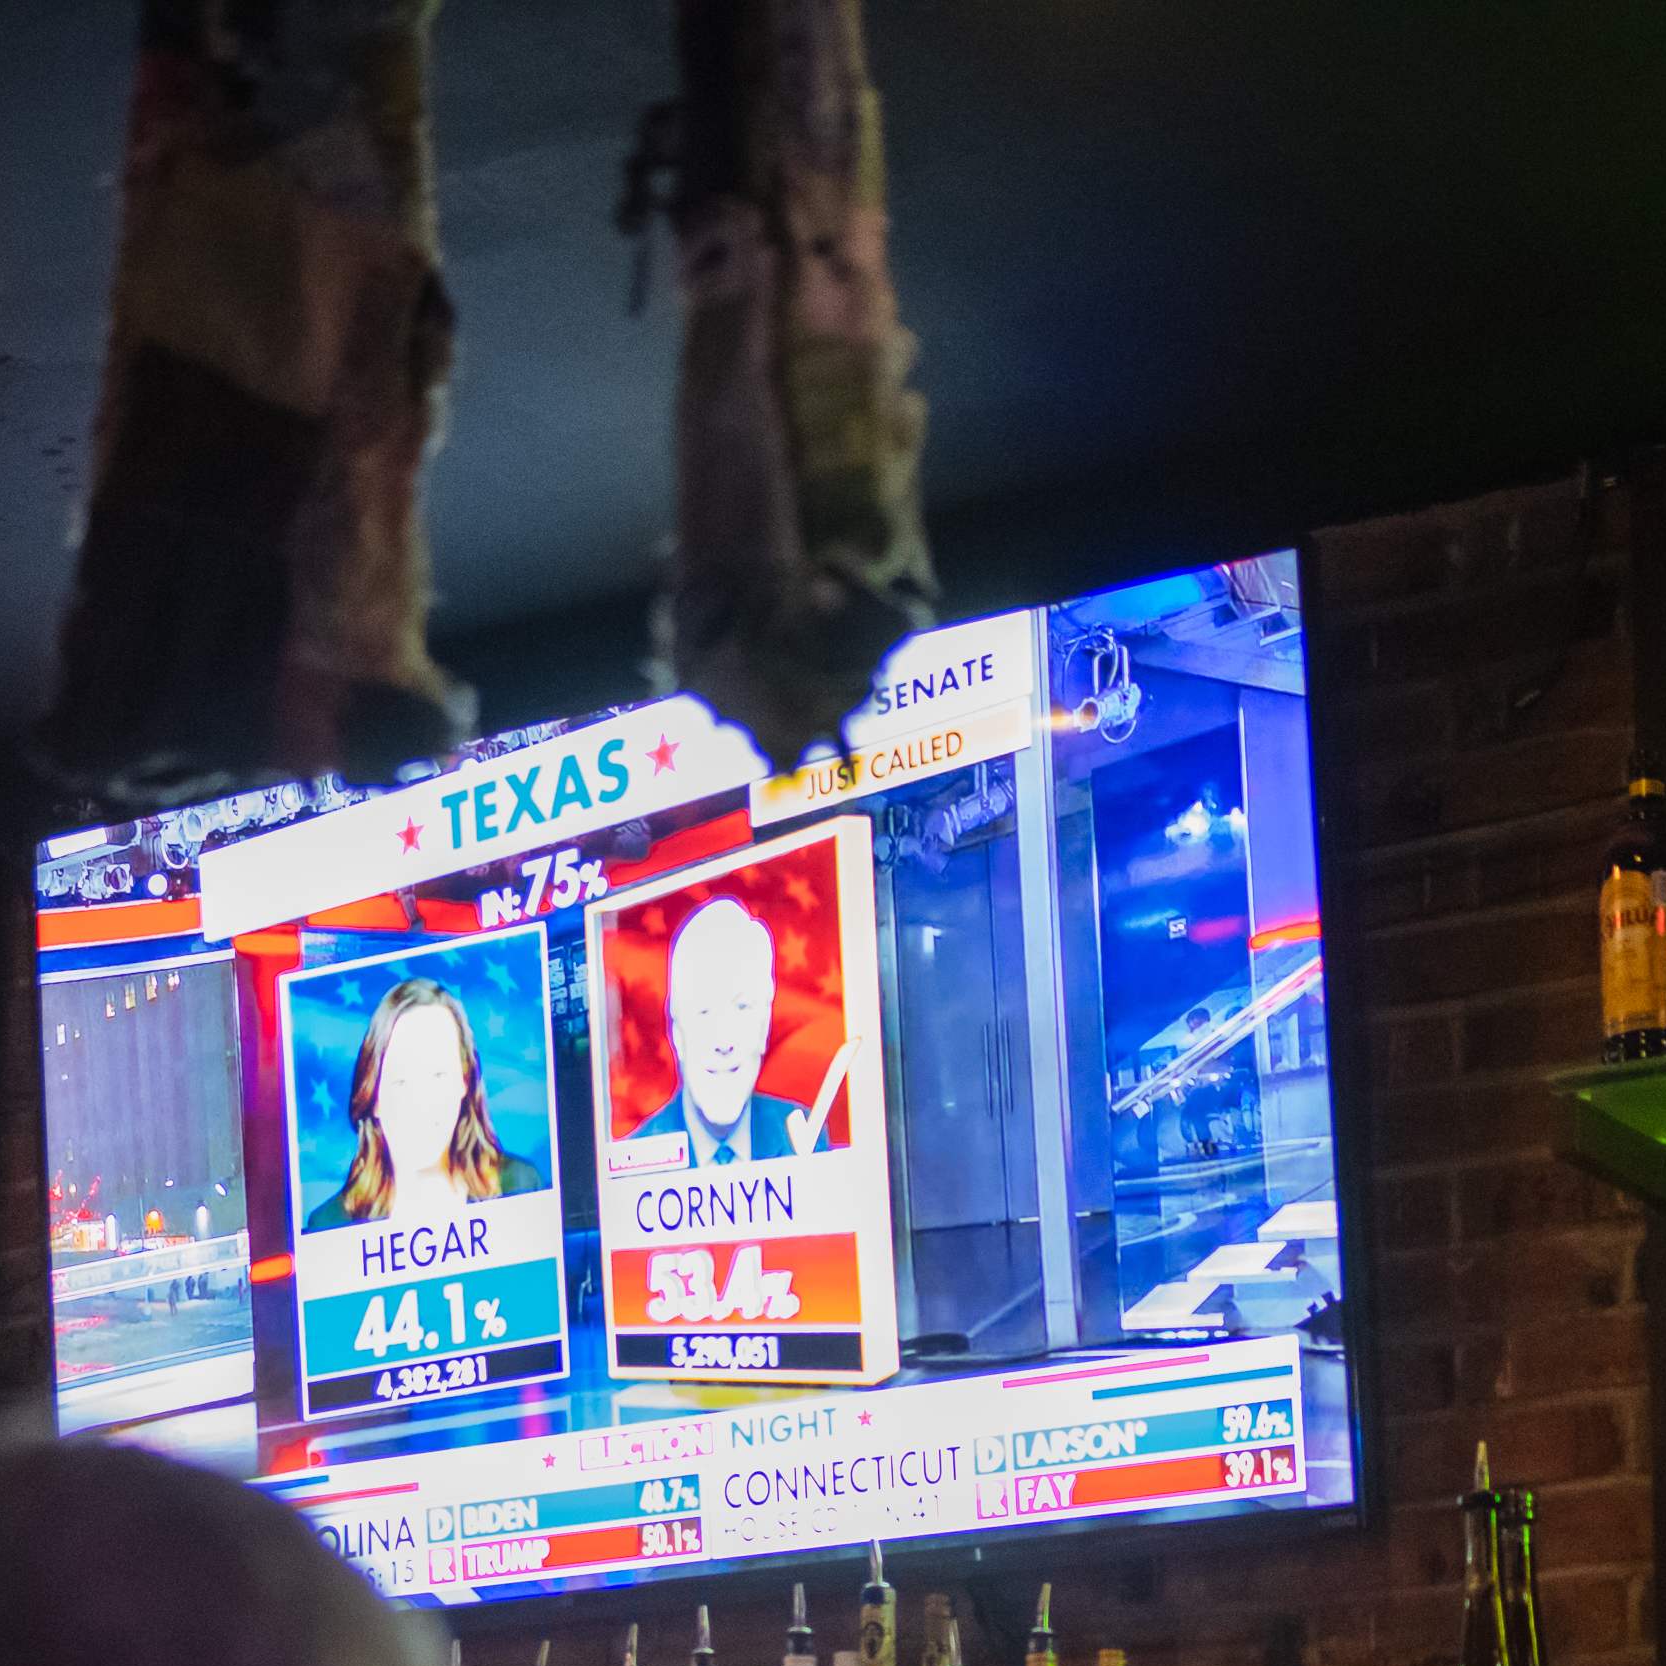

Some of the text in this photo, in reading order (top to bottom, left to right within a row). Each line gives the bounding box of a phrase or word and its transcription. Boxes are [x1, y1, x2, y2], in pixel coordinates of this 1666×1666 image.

[876, 652, 995, 716] SENATE
[441, 738, 631, 850] TEXAS
[808, 730, 964, 800] JUST CALLED
[521, 847, 610, 914] 75%
[636, 1175, 795, 1233] CORNYN
[361, 1217, 490, 1277] HEGAR
[353, 1281, 508, 1358] 44.1%
[731, 1407, 837, 1450] NIGHT
[976, 1435, 1005, 1472] D
[724, 1445, 963, 1510] CONNECTICUT
[978, 1483, 1007, 1520] R
[1017, 1471, 1077, 1514] FAY
[319, 1515, 416, 1560] OLINA
[434, 1506, 454, 1542] D
[462, 1498, 539, 1538] BIDEN
[391, 1558, 415, 1587] 15
[432, 1521, 702, 1584] R TRUMP 50.1%
